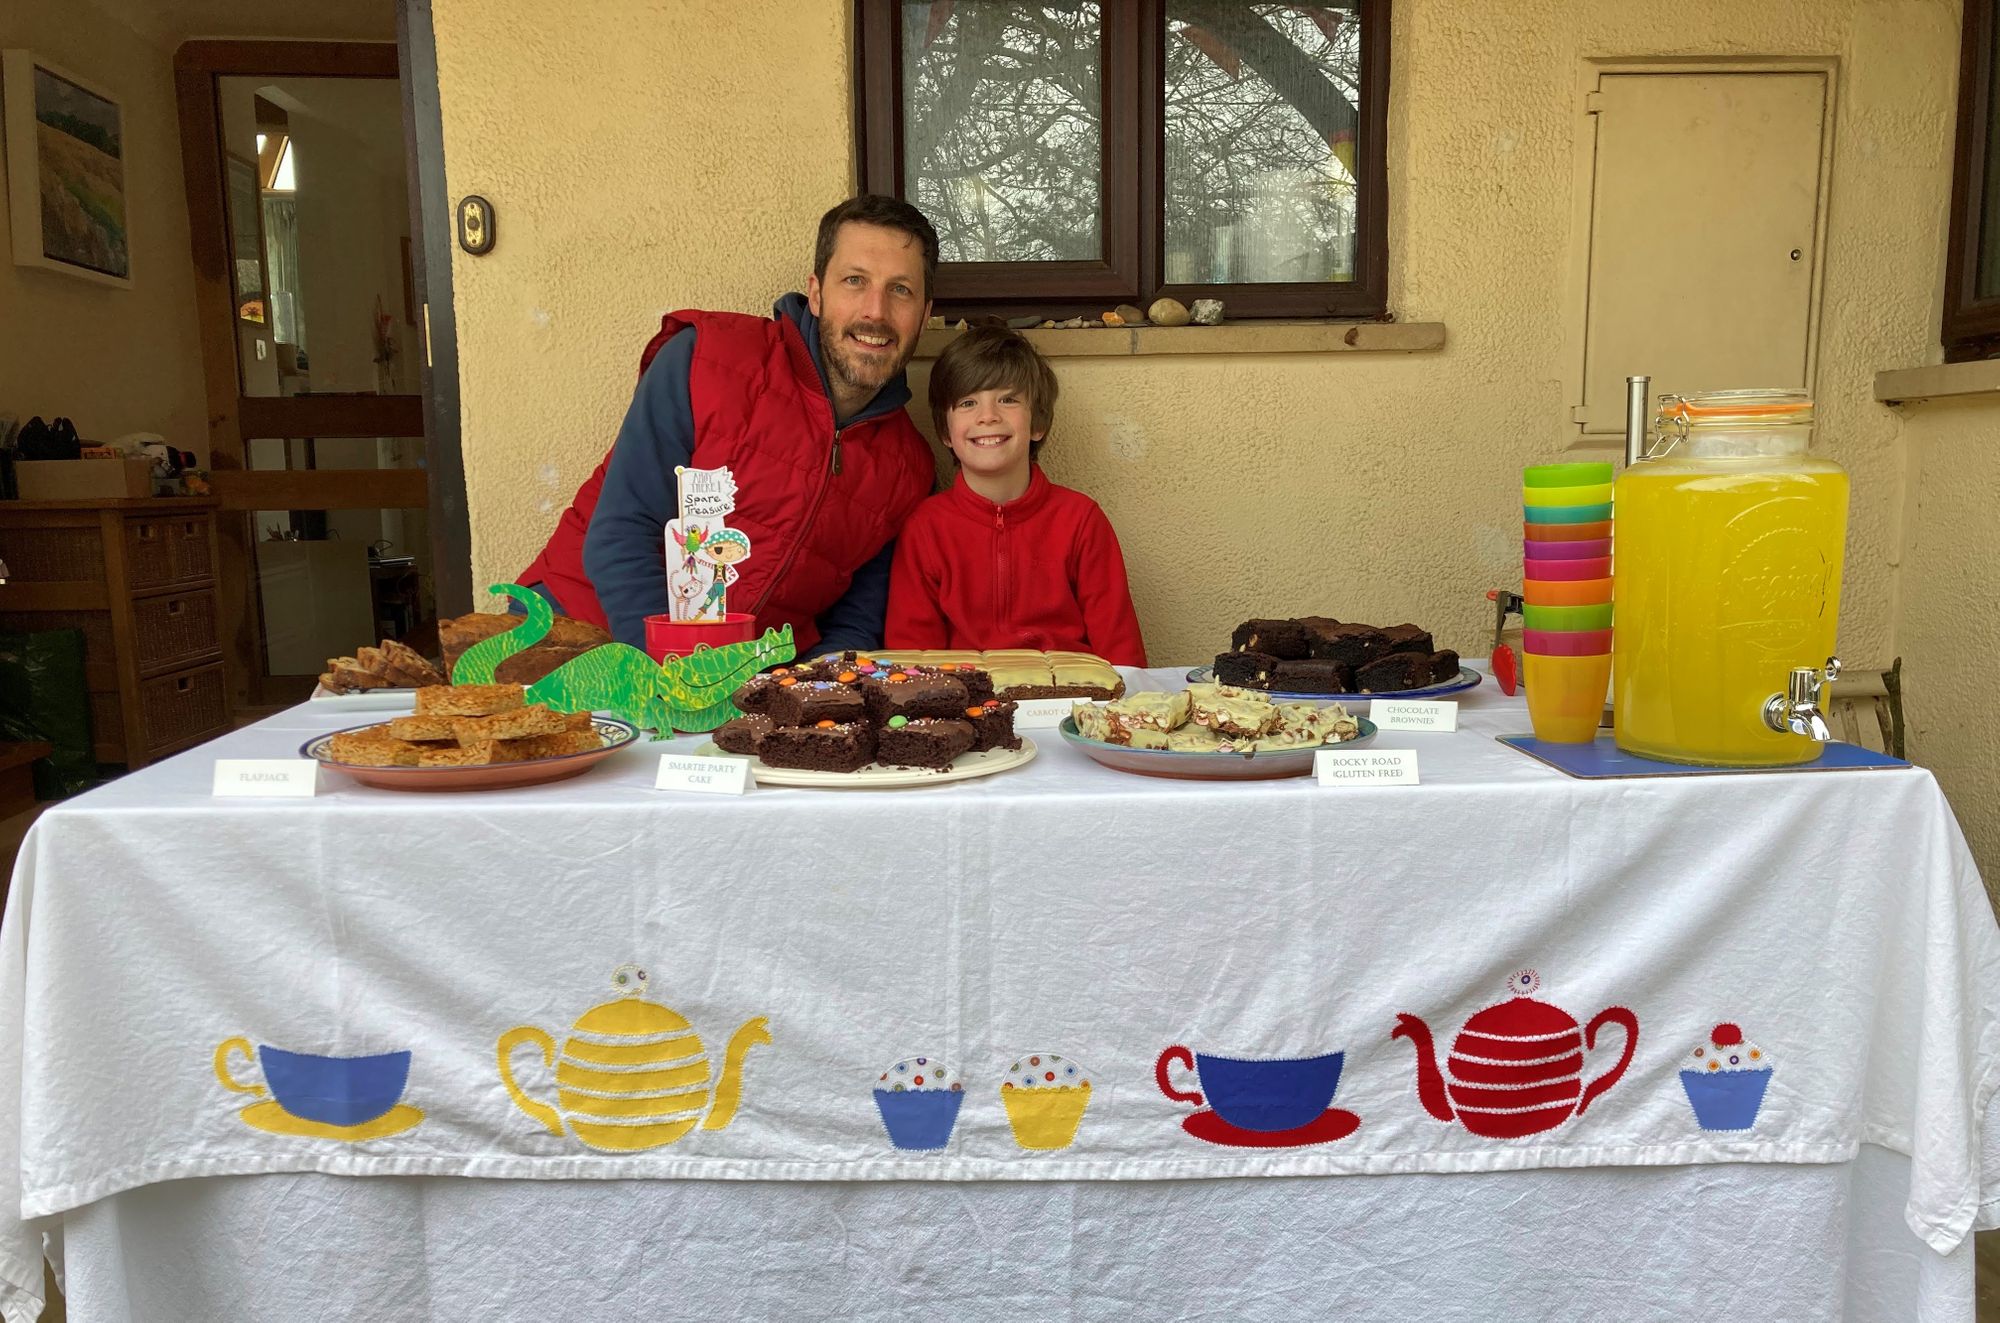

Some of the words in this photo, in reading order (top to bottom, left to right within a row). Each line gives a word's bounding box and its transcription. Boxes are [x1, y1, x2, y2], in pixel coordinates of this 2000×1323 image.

[685, 494, 721, 506] Spare
[684, 503, 730, 515] Treasure
[1387, 706, 1439, 715] CHOCOLATE
[1390, 716, 1434, 725] BROWNIES
[1333, 758, 1368, 767] ROCKY
[1372, 757, 1401, 766] ROAD
[668, 761, 705, 772] SMARTIE
[707, 764, 736, 774] PARTY
[239, 773, 289, 782] FLAPJACK
[687, 775, 712, 784] CAKE
